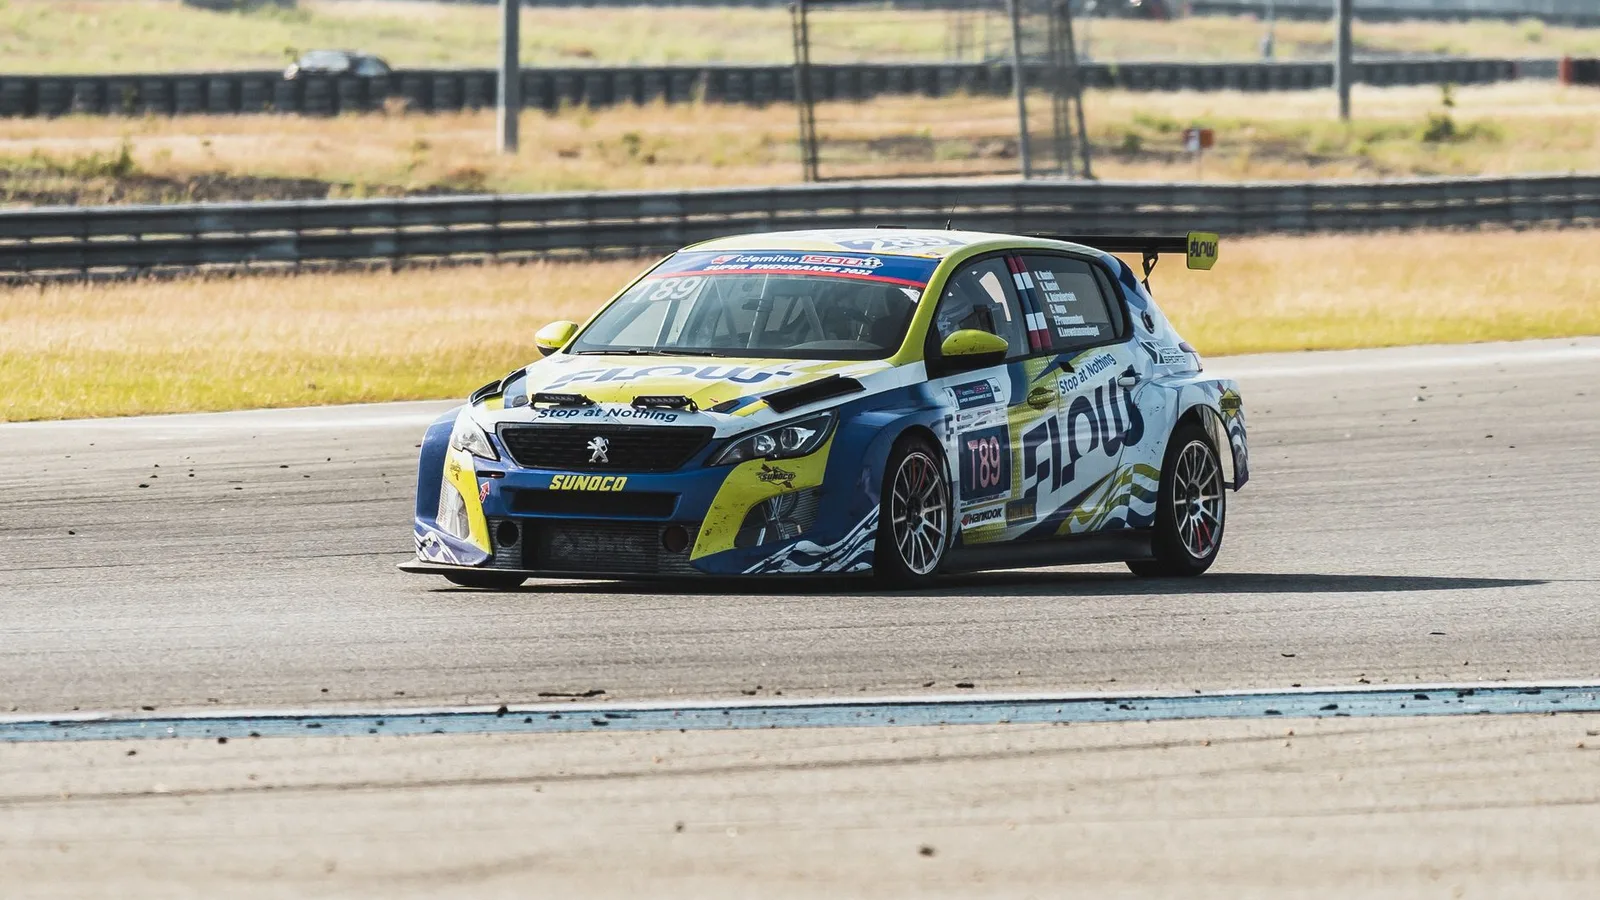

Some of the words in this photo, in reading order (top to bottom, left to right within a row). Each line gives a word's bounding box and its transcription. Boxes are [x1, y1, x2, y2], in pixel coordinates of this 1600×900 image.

[736, 254, 799, 263] idemitsu
[801, 255, 862, 266] 1500
[751, 264, 840, 273] ENDURANCE
[631, 275, 702, 303] T89
[543, 366, 780, 391] FLOW
[1059, 378, 1079, 395] Stop
[1080, 367, 1088, 383] at
[1085, 352, 1117, 378] Nothing
[538, 408, 580, 418] Stop
[584, 408, 603, 417] at
[604, 408, 679, 423] Nothing
[1023, 376, 1145, 498] FLOW
[967, 435, 1000, 490] T89
[549, 474, 628, 491] SUNOCO
[761, 472, 793, 481] SUNOCO
